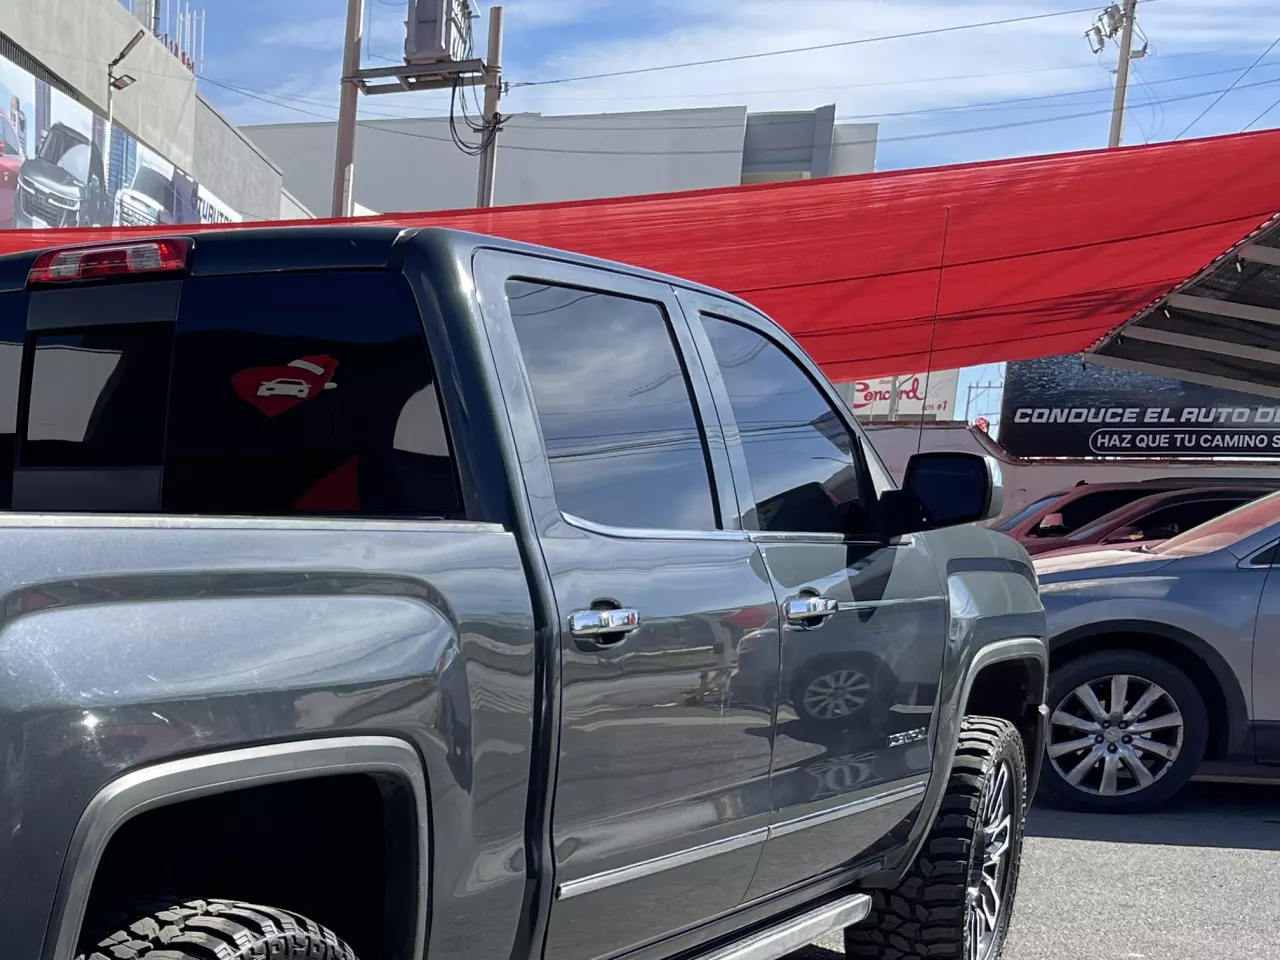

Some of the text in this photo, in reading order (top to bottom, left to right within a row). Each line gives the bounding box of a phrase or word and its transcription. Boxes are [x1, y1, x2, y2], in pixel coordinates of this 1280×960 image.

[1013, 407, 1140, 423] CONDUCE
[1143, 407, 1176, 423] EL
[1180, 407, 1250, 423] AUTO
[1096, 434, 1133, 447] HAZ
[1135, 434, 1170, 448] QUE
[1173, 434, 1197, 447] TU
[1200, 434, 1268, 448] CAMINO
